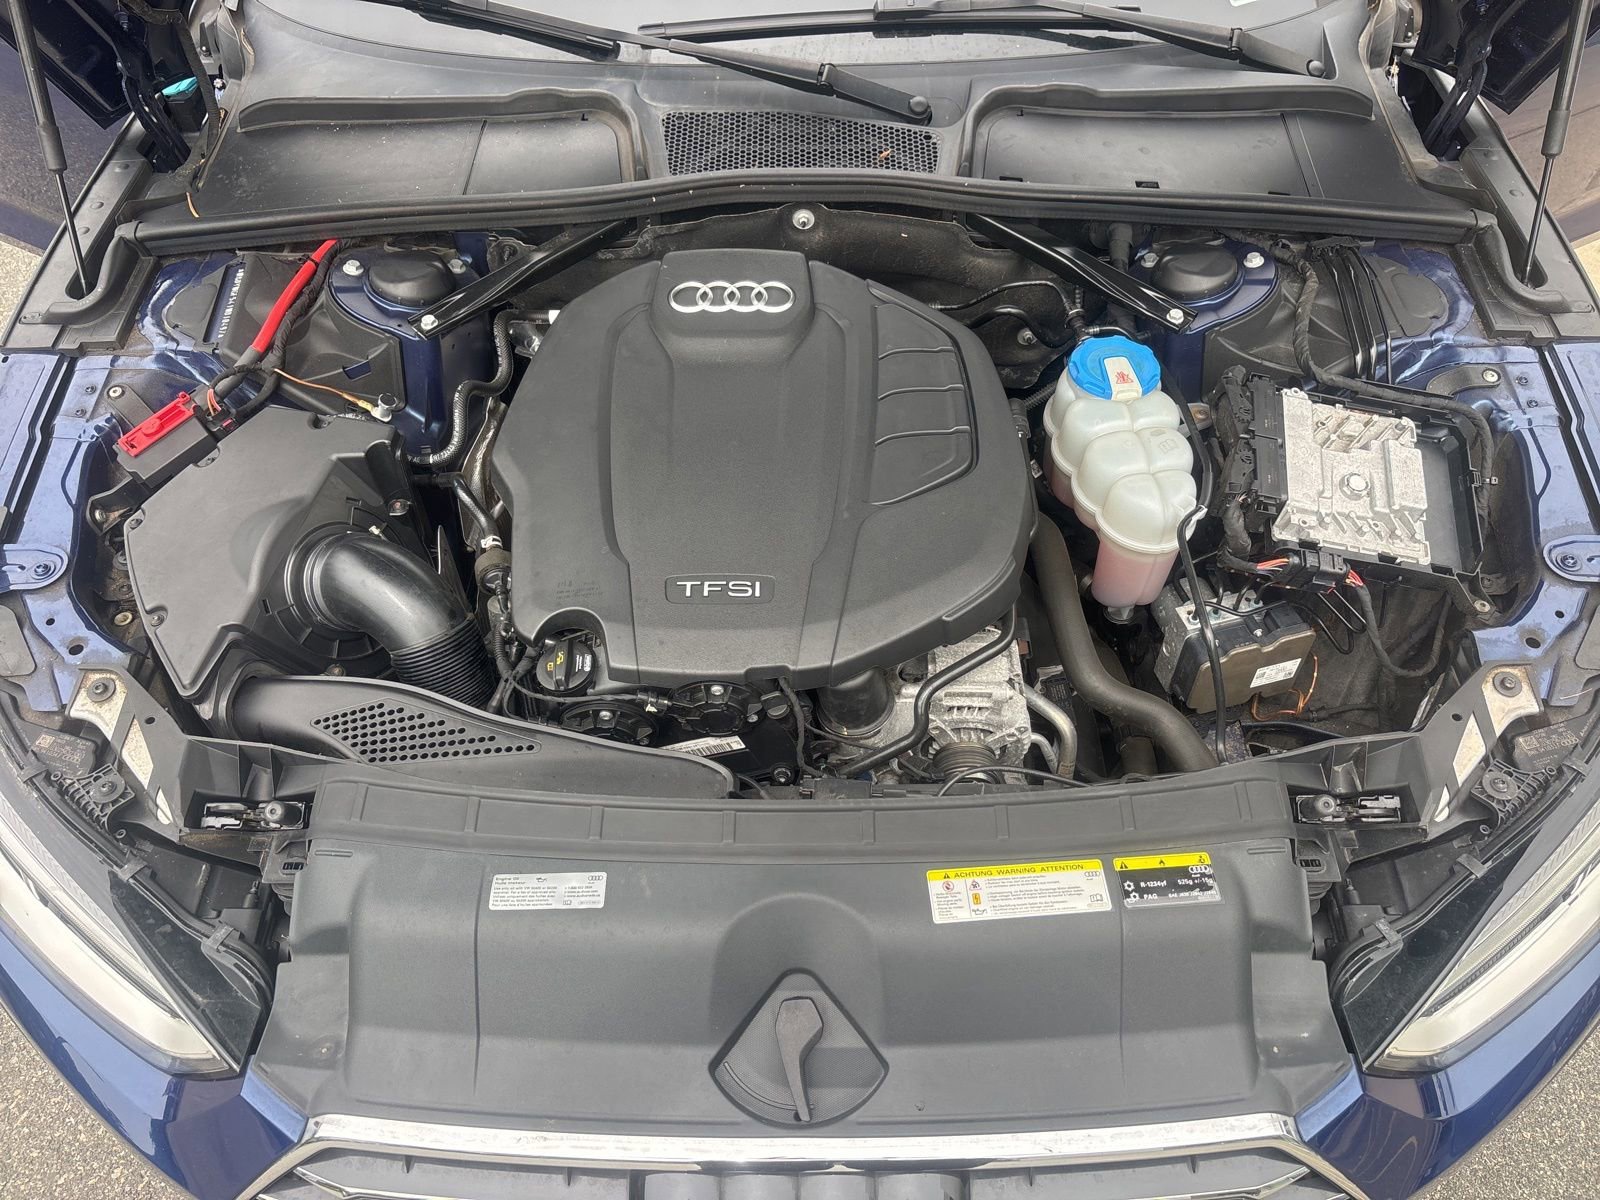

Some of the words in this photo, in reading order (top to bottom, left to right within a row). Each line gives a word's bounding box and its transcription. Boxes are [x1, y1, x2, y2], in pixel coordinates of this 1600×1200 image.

[676, 581, 761, 597] TFSI
[954, 870, 993, 878] ACHTUNG
[996, 867, 1036, 875] WARNING
[1040, 864, 1084, 872] ATTENTION
